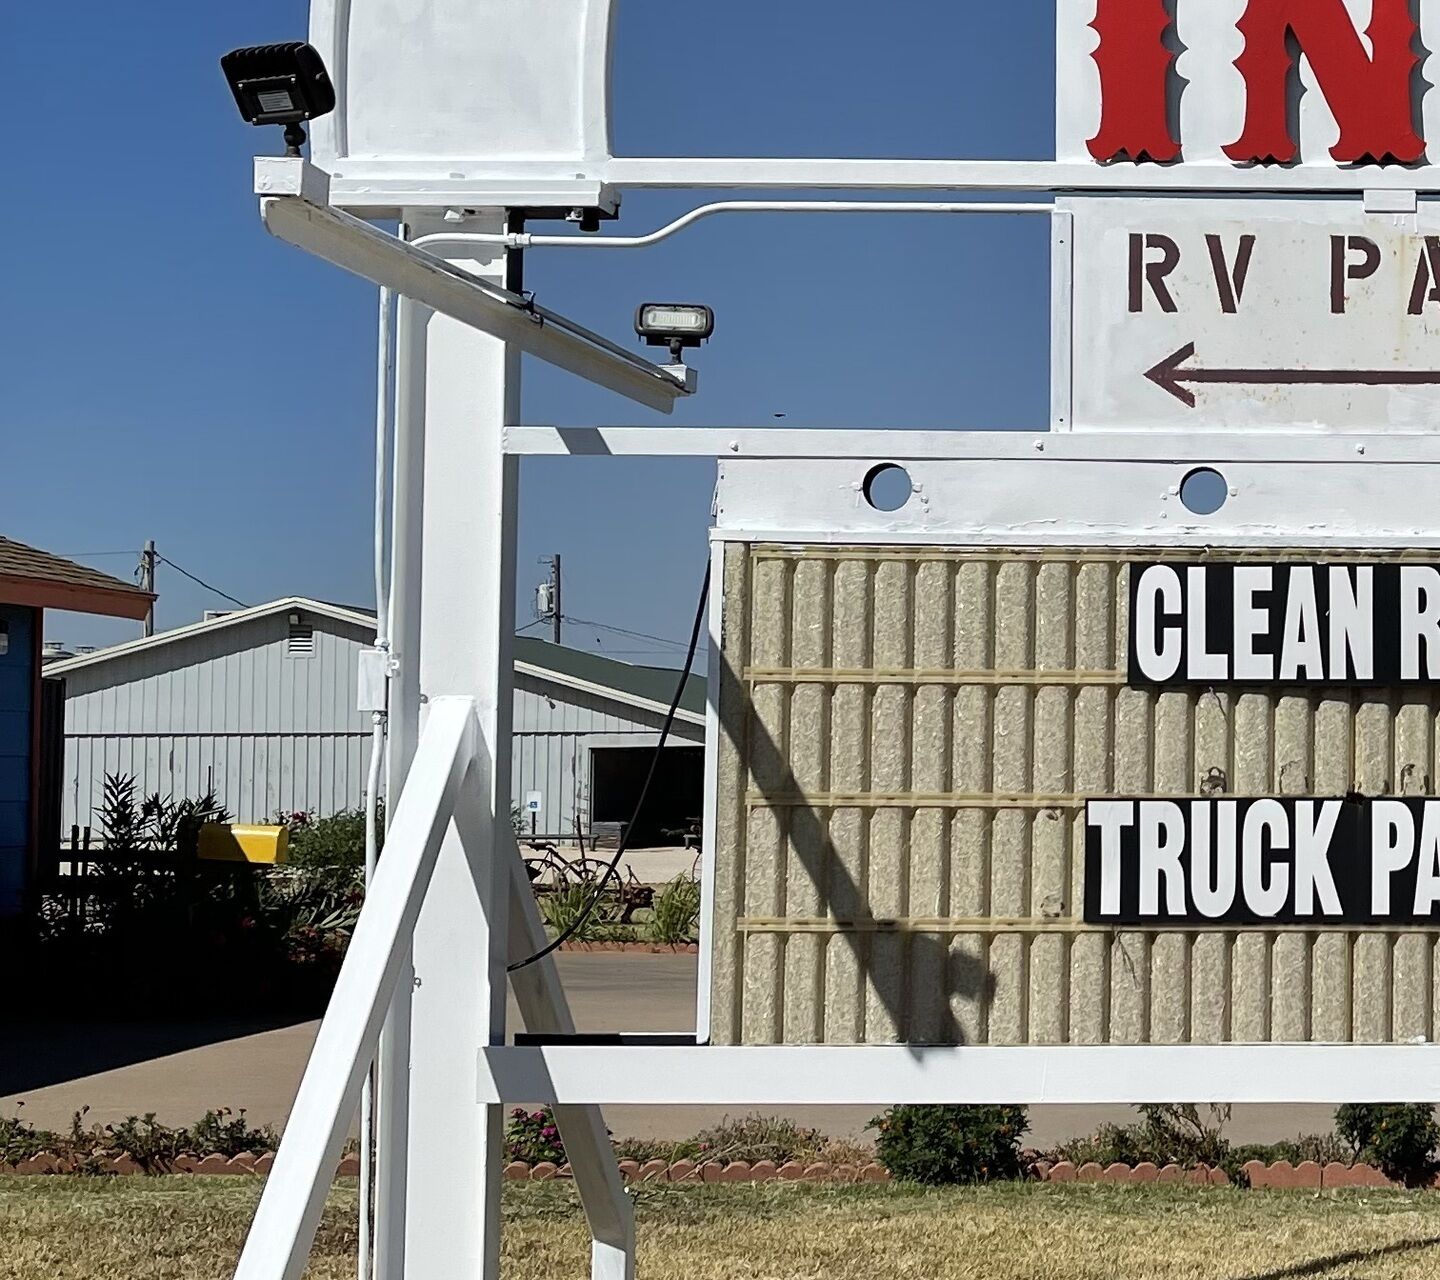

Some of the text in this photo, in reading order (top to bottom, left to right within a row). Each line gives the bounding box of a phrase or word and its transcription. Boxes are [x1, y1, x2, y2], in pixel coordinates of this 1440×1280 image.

[1128, 232, 1256, 314] RV
[1135, 564, 1374, 682] CLEAN
[1087, 799, 1344, 917] TRUCK
